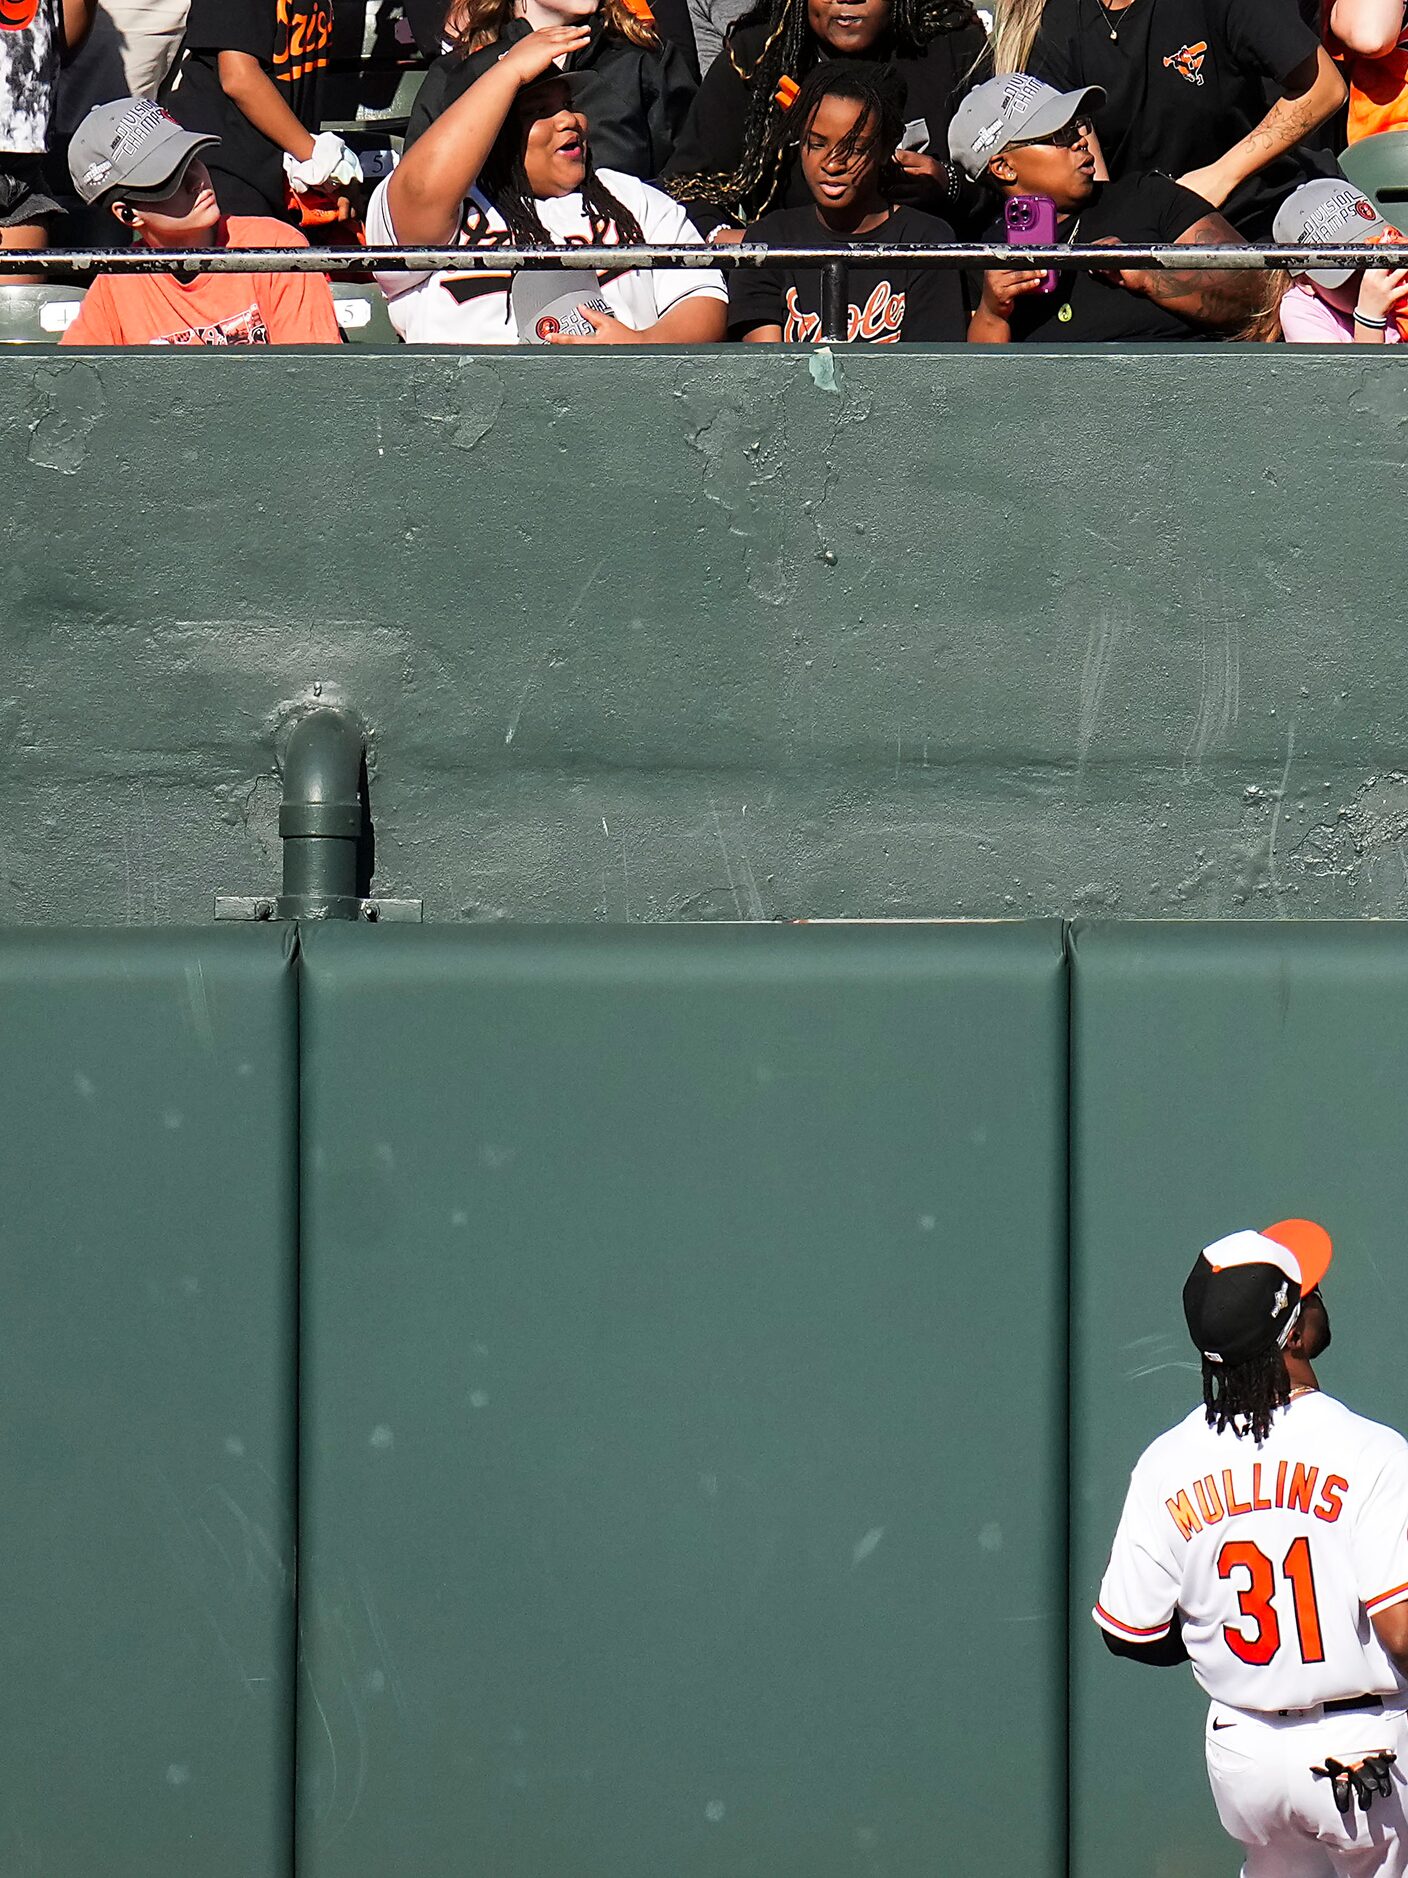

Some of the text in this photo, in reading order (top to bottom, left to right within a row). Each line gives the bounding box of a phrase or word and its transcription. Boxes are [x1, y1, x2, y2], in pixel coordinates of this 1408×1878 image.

[372, 154, 383, 173] 5
[1308, 203, 1358, 243] HAMPS
[343, 304, 354, 323] 5
[1165, 1461, 1349, 1542] MULLINS
[1217, 1536, 1326, 1666] 31
